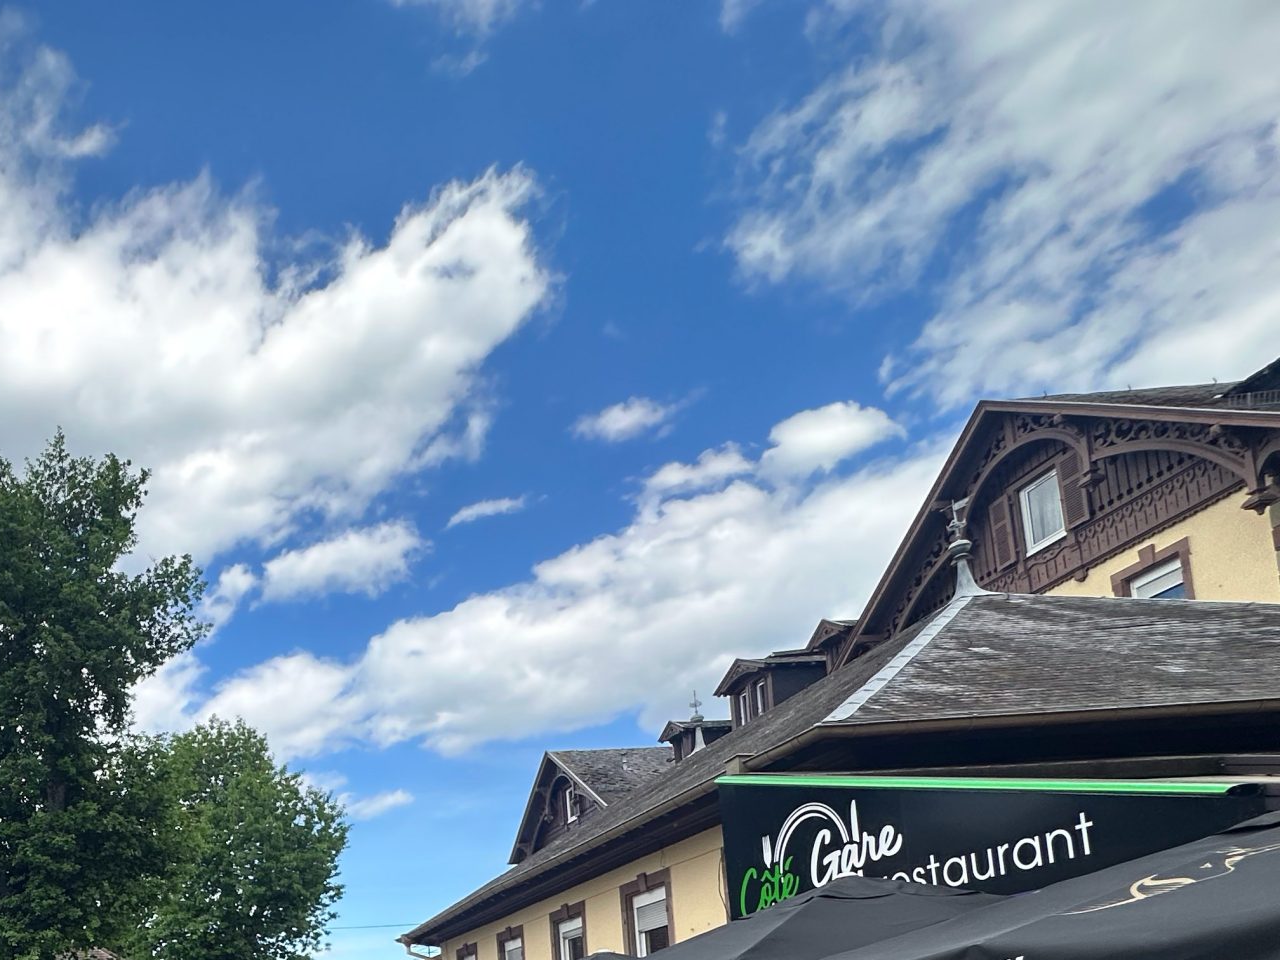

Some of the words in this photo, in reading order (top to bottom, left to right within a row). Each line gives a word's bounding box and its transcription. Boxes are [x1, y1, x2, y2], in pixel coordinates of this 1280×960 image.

[740, 856, 800, 917] Côté
[810, 824, 903, 888] Gare
[883, 812, 1094, 888] staurant
